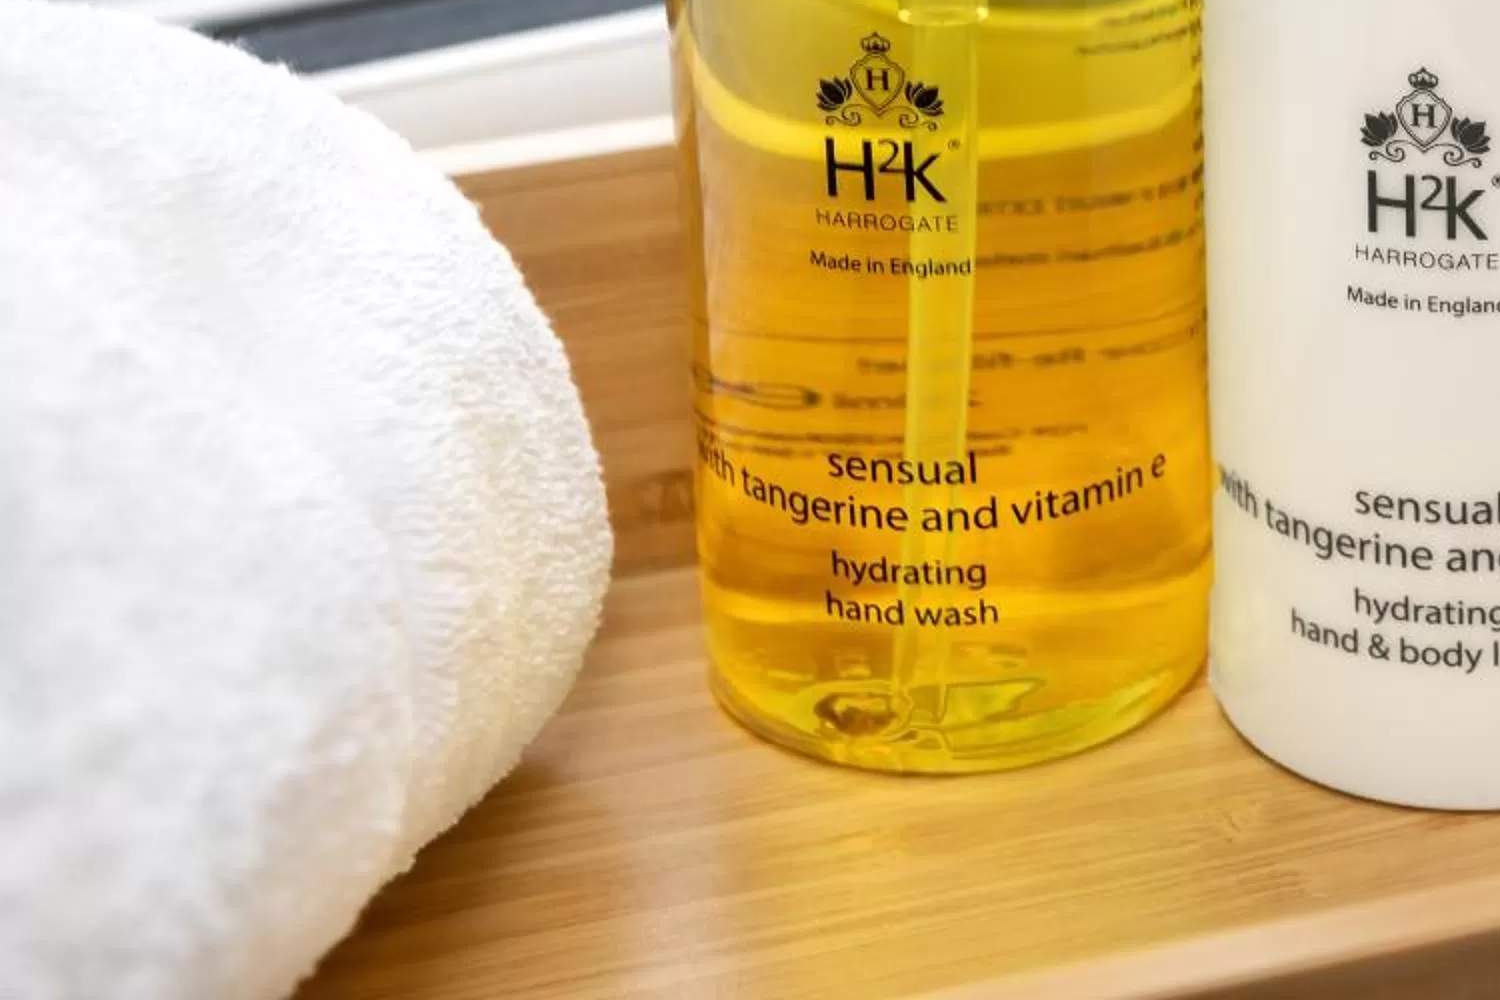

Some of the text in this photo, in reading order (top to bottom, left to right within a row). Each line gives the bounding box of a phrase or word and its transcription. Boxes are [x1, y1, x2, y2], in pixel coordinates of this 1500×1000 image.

[866, 67, 891, 91] H
[1410, 103, 1438, 129] H
[815, 207, 960, 234] HARROGATE
[809, 249, 972, 279] Made in England
[1354, 243, 1500, 271] HARROGATE
[1346, 284, 1399, 309] Made
[1403, 293, 1422, 311] in
[827, 451, 978, 485] sensual
[742, 466, 909, 532] tangerine
[921, 498, 998, 532] and
[1010, 464, 1144, 526] vitamin
[1151, 452, 1167, 478] e
[1265, 498, 1433, 571] tangerine
[831, 549, 988, 589] hydrating
[826, 591, 998, 628] hand wash
[1291, 608, 1359, 655] hand
[1368, 633, 1391, 661] &
[1400, 636, 1483, 674] body
